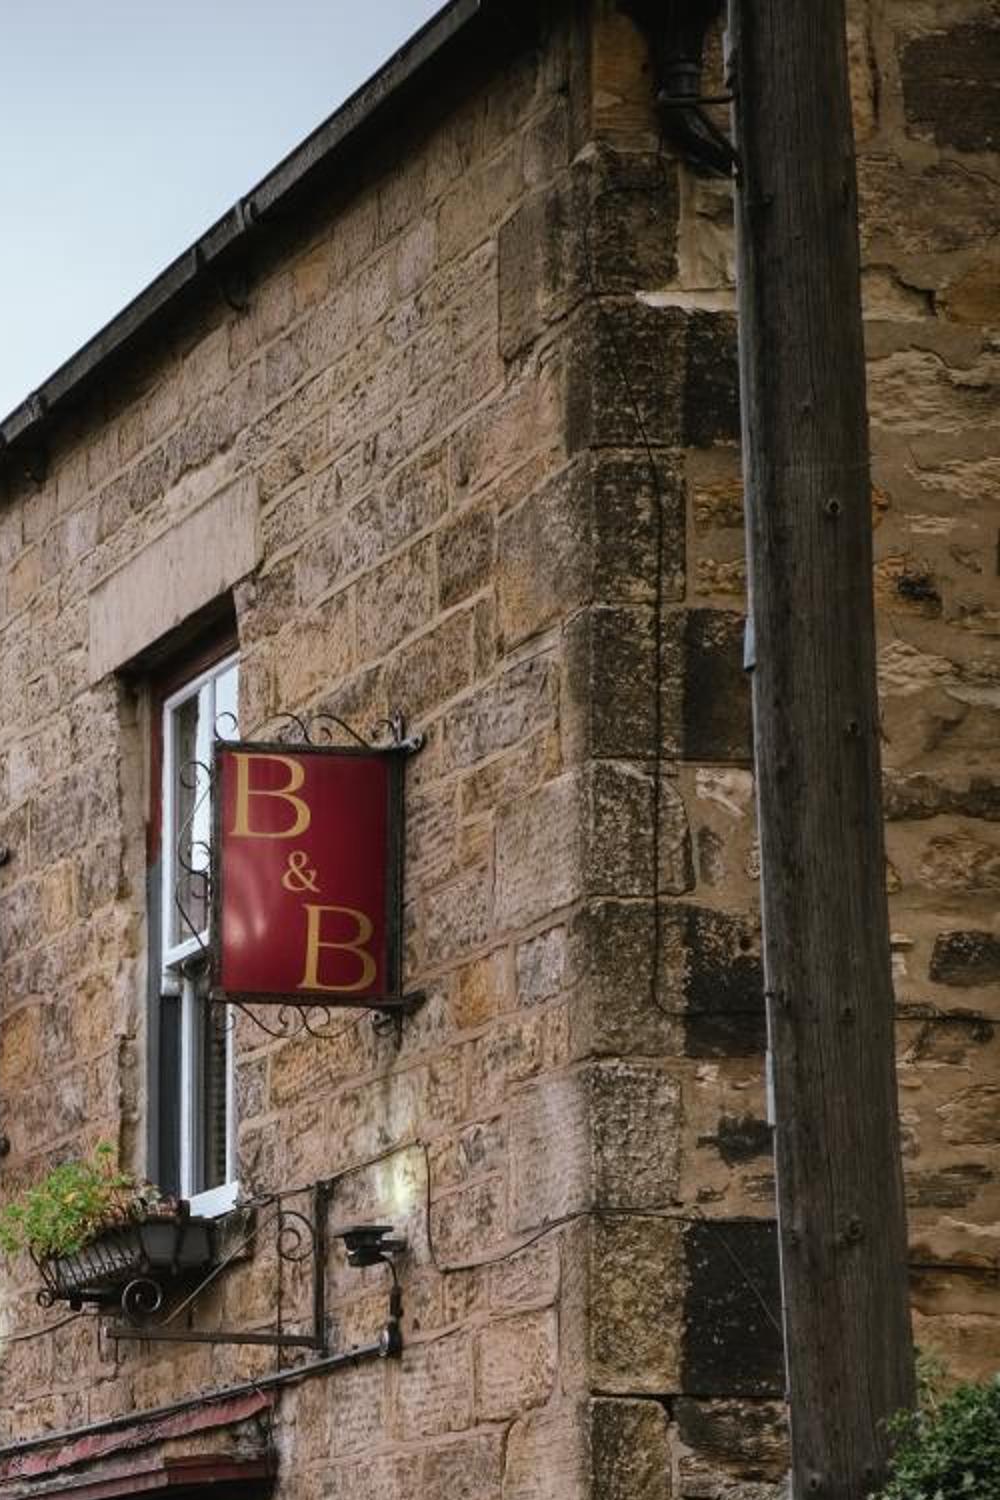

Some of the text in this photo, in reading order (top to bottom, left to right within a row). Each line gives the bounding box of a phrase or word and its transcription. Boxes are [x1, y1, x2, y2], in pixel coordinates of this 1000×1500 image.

[228, 752, 311, 839] B
[281, 850, 320, 892] &
[296, 903, 377, 991] B
